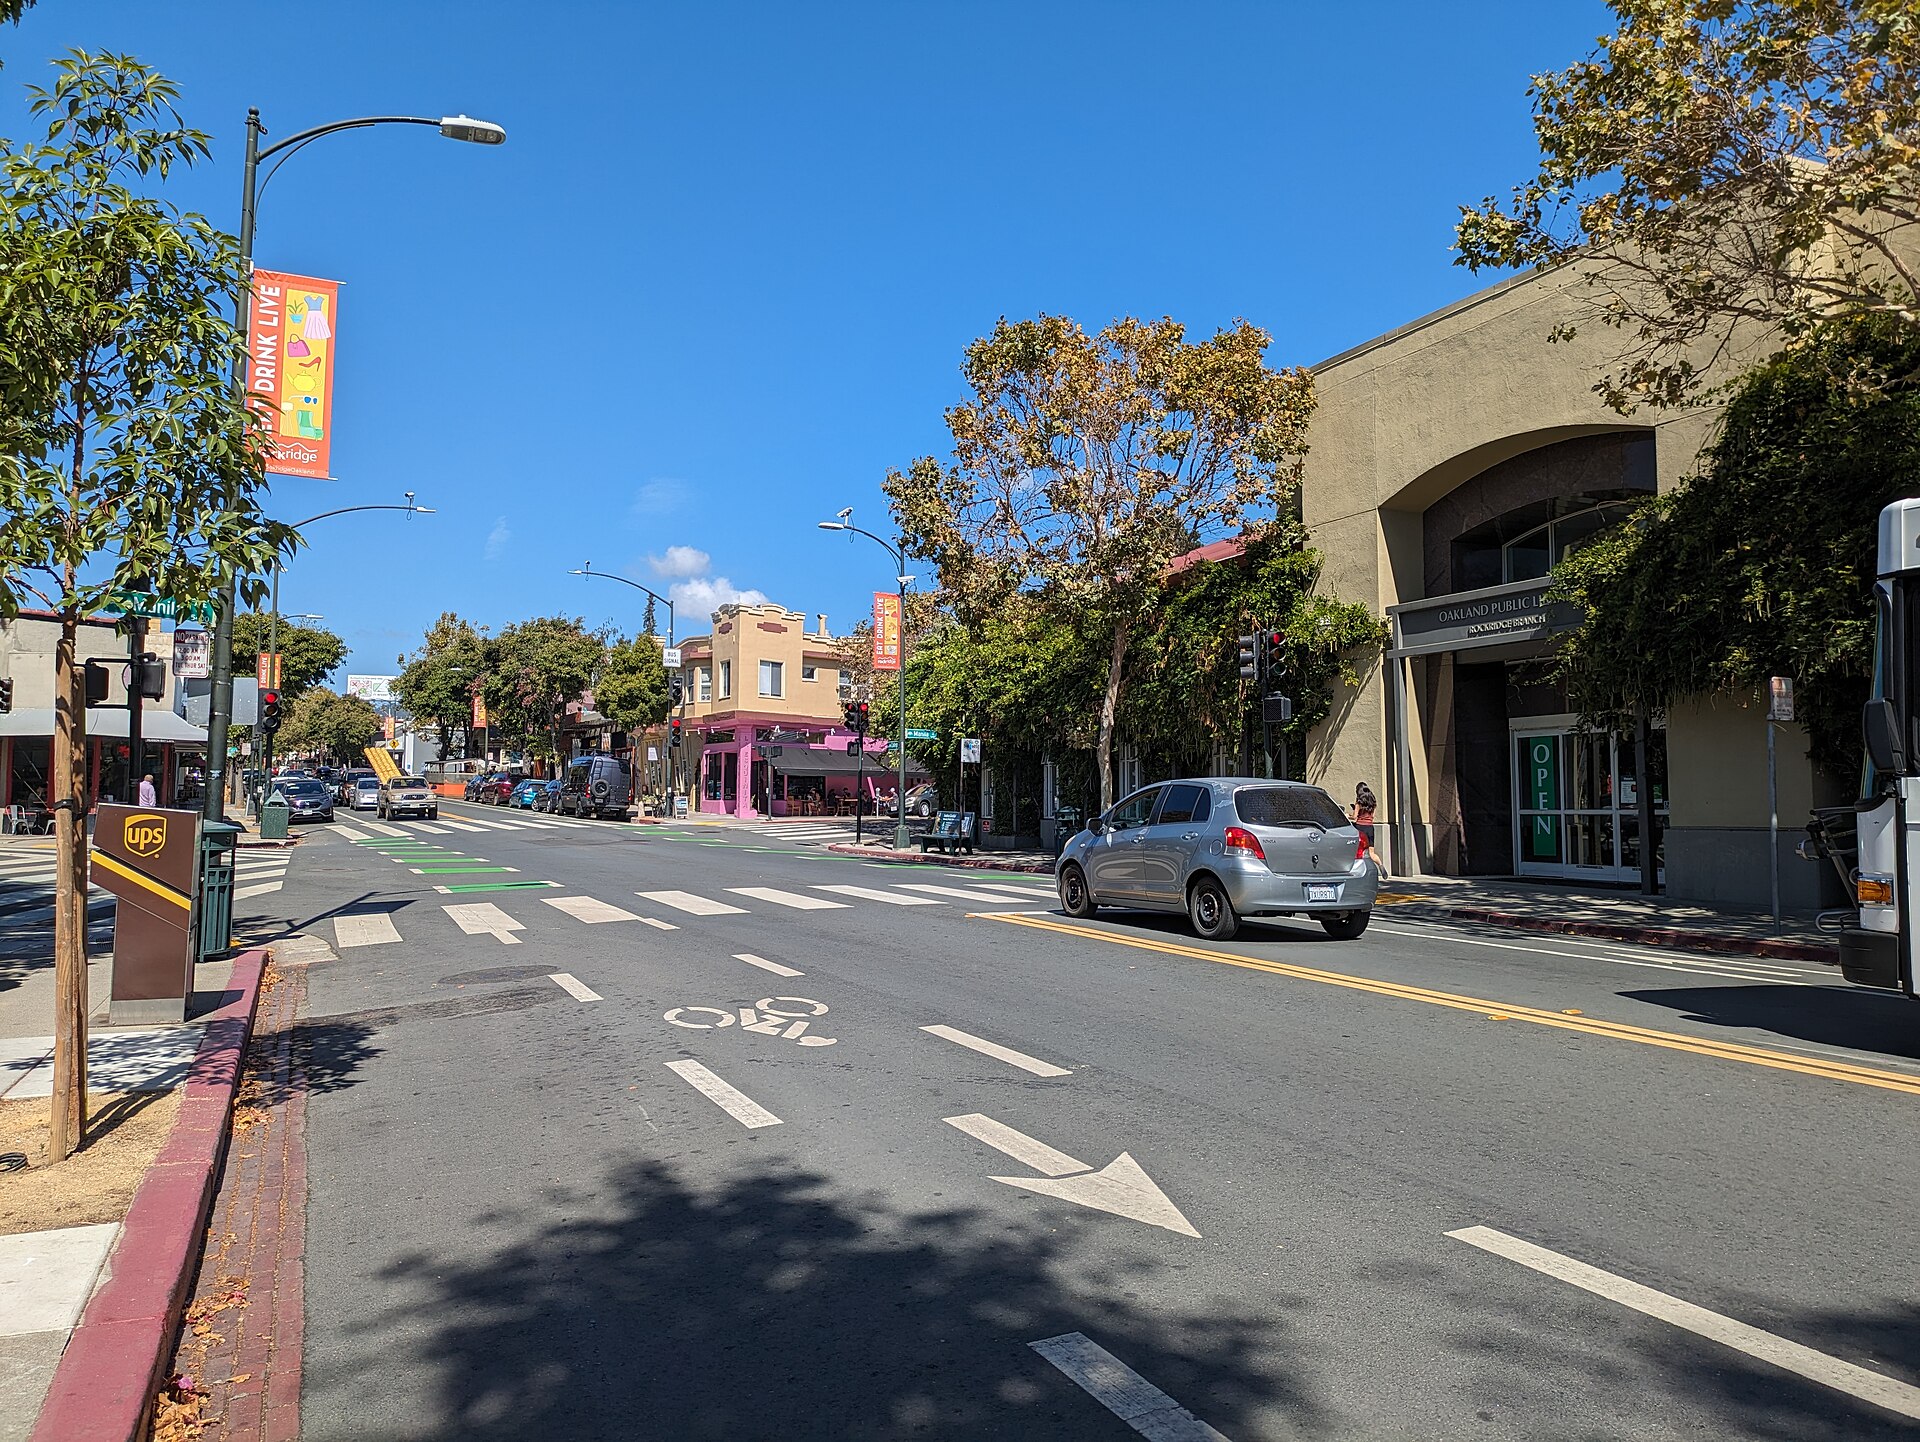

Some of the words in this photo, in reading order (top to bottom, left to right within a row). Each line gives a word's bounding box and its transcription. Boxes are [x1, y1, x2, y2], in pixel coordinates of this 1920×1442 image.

[257, 284, 281, 327] LIVE
[254, 332, 278, 393] DRINK
[1439, 604, 1489, 623] OAKLAND
[1491, 596, 1531, 614] PUBLIC
[876, 616, 884, 639] DRINK
[1469, 618, 1512, 634] ROCKRIDGE
[1513, 613, 1546, 627] BRANCH
[176, 632, 185, 642] NO
[876, 641, 884, 655] EAT
[1532, 743, 1551, 836] OPEN
[127, 827, 163, 850] ups
